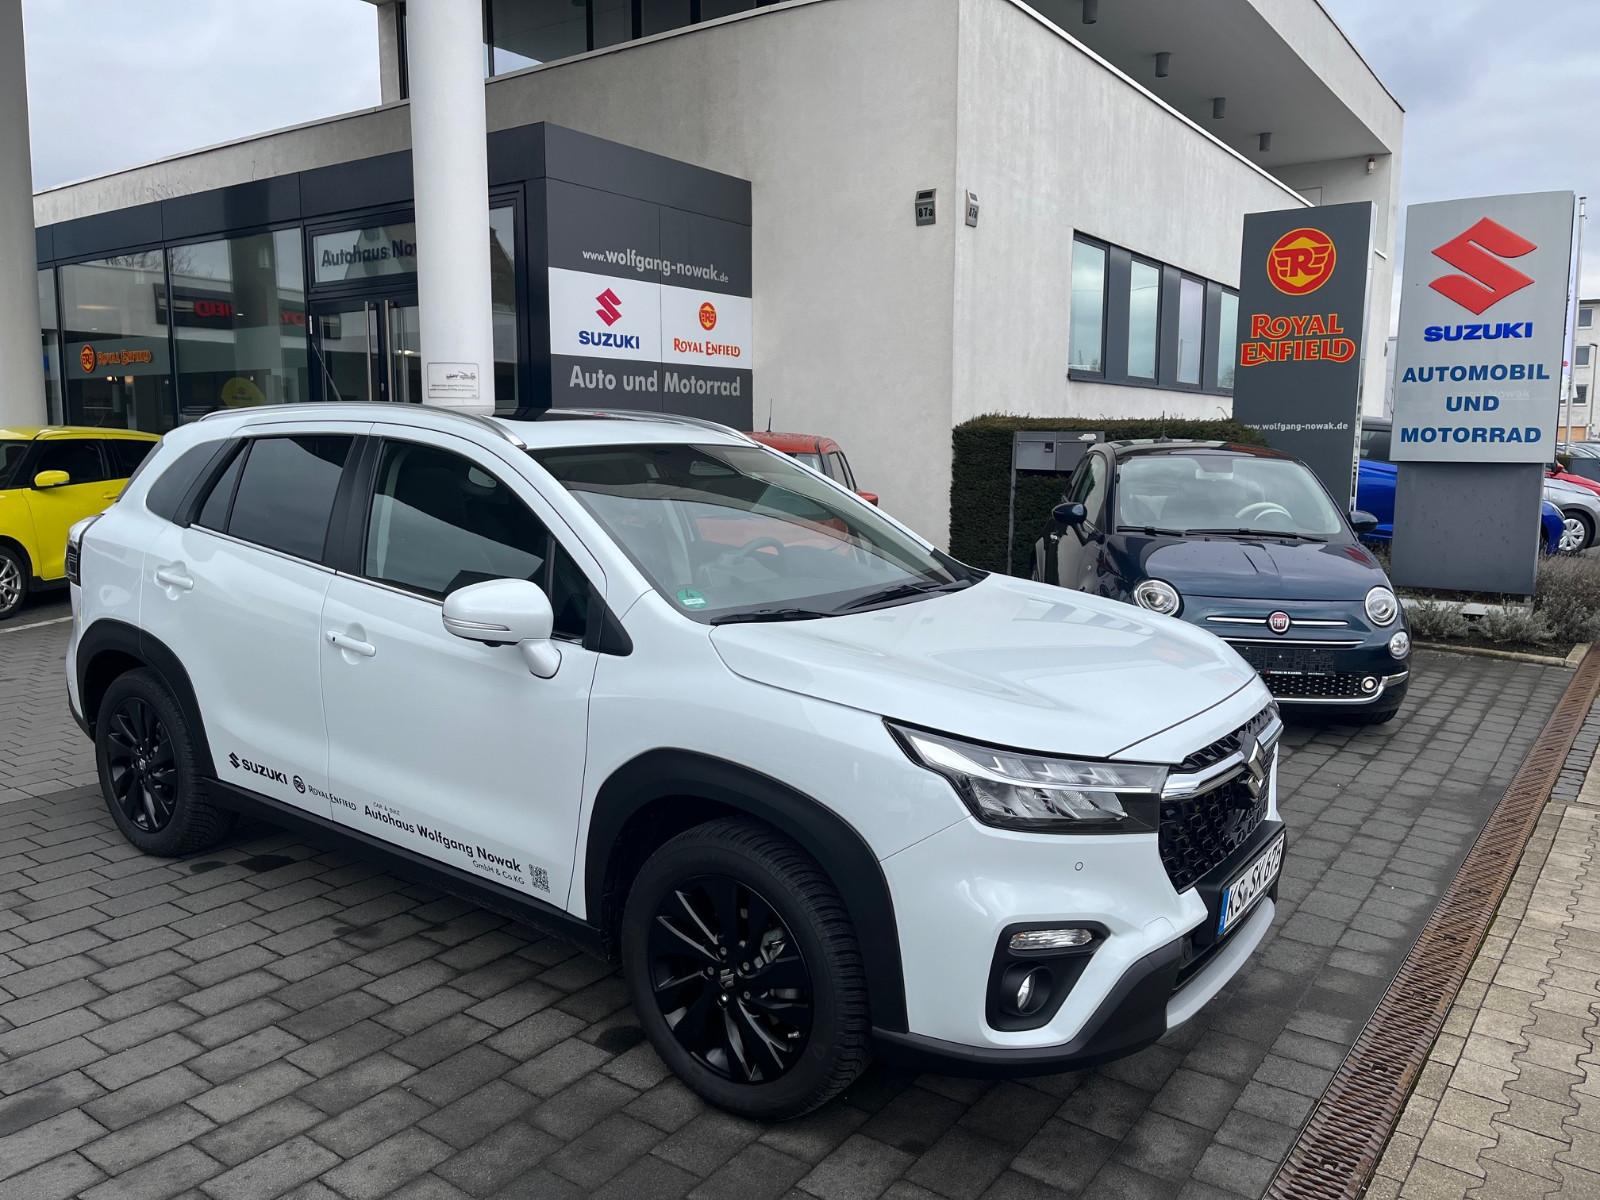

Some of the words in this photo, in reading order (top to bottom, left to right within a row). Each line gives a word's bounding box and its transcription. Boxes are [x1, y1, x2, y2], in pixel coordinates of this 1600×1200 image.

[321, 244, 388, 267] Autohaus
[391, 239, 416, 258] No
[582, 248, 729, 283] www.wolfgang-nowak.de
[1250, 313, 1344, 340] ROYAL
[1424, 321, 1533, 342] SUZUKI
[578, 330, 640, 350] SUZUKI
[673, 337, 704, 353] ROYAL
[706, 341, 741, 358] ENFIELD
[1240, 337, 1356, 367] ENFIELD
[569, 365, 617, 390] Auto
[623, 370, 658, 392] und
[664, 371, 741, 396] Motorrad
[1402, 363, 1550, 383] AUTOMOBIL
[1445, 395, 1500, 412] UND
[1243, 421, 1349, 432] ww.wolfgang-nowak.de
[1400, 426, 1542, 443] MOTORRAD
[241, 759, 289, 785] SUZUKI
[308, 784, 329, 800] ROYAL
[329, 793, 357, 811] ENFIELD
[364, 805, 415, 833] Autohaus
[416, 823, 474, 858] Wolfgang
[476, 846, 522, 873] Nowak
[472, 860, 495, 873] GmbH
[1227, 879, 1245, 921] KS
[1249, 857, 1266, 898] SK
